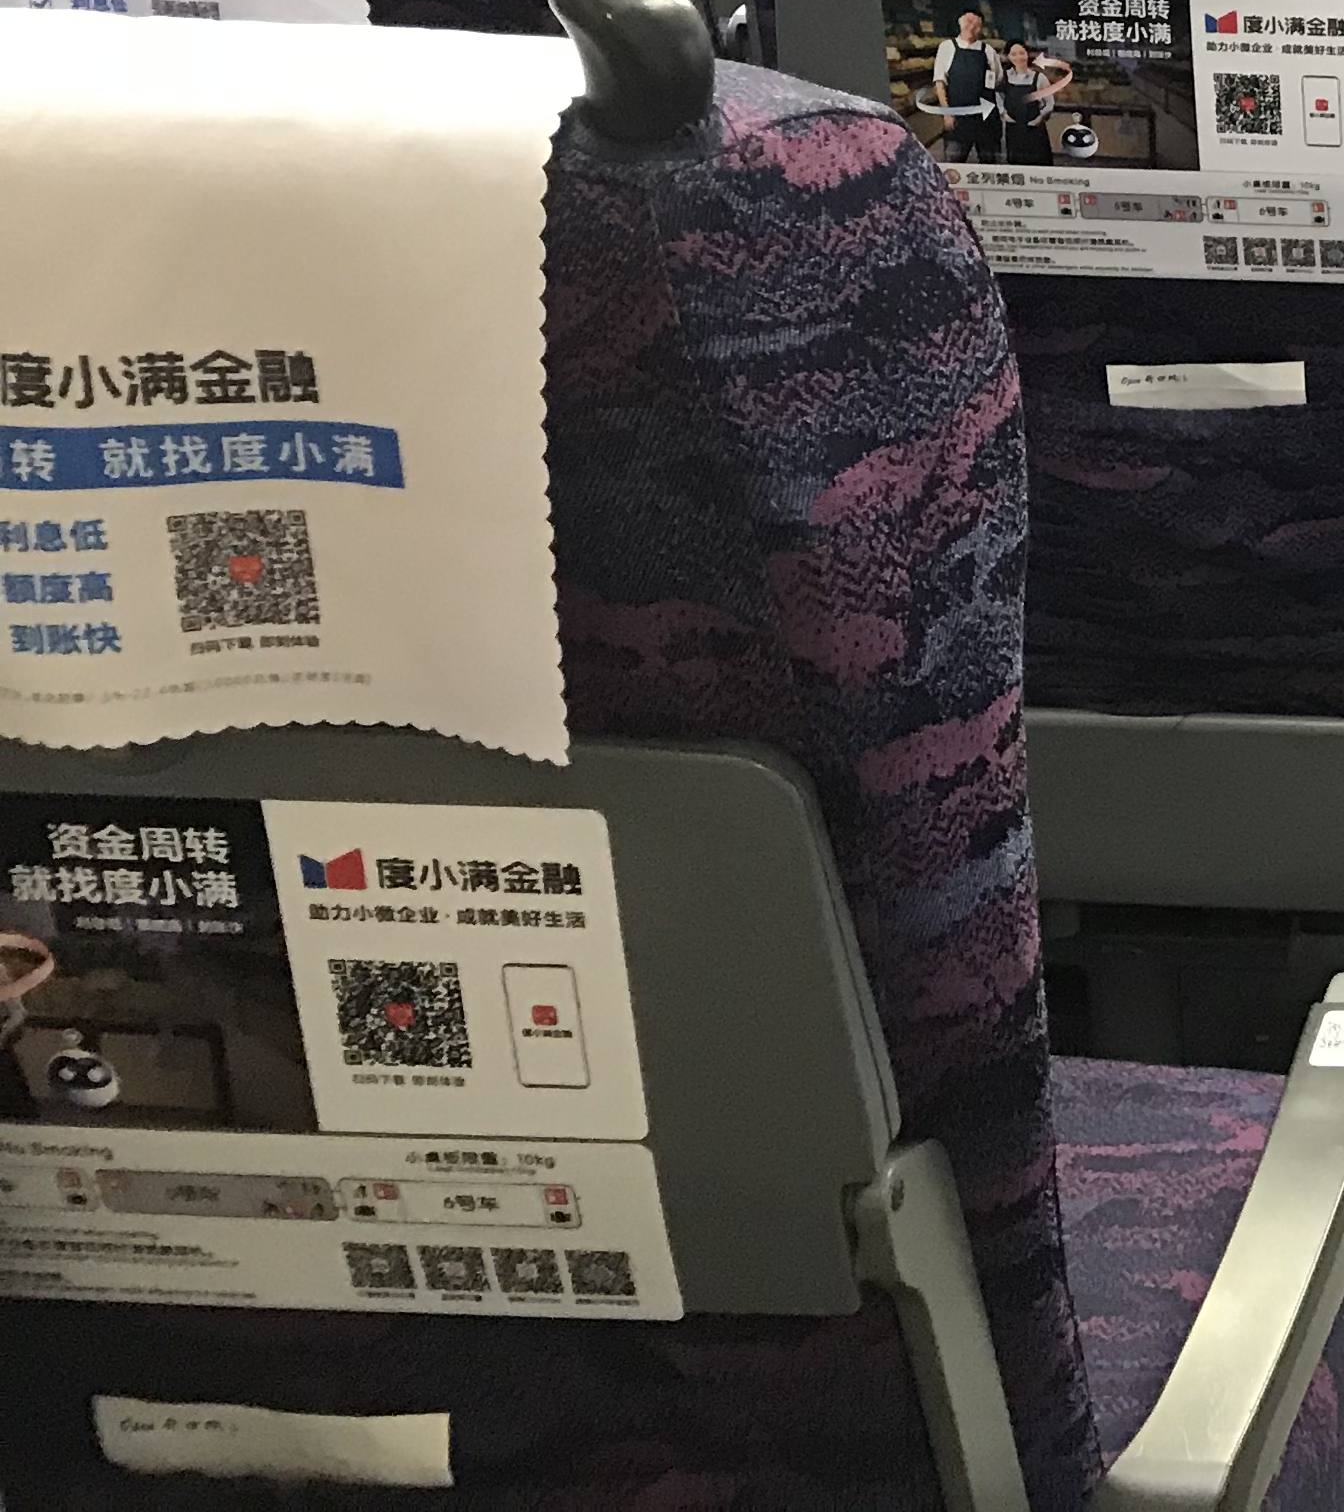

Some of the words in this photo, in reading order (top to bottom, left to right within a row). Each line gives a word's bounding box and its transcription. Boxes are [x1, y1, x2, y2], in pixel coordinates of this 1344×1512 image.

[1055, 19, 1172, 45] 就找度小满
[0, 349, 320, 408] 度小满金融
[9, 438, 56, 482] 转
[98, 432, 376, 479] 就找度小满
[0, 519, 108, 552] 利息低
[2, 572, 114, 604] 额度高
[10, 621, 123, 656] 到账快
[47, 823, 231, 865] 资金周转
[8, 863, 240, 909] 就找度小满
[375, 856, 583, 896] 度小满金融
